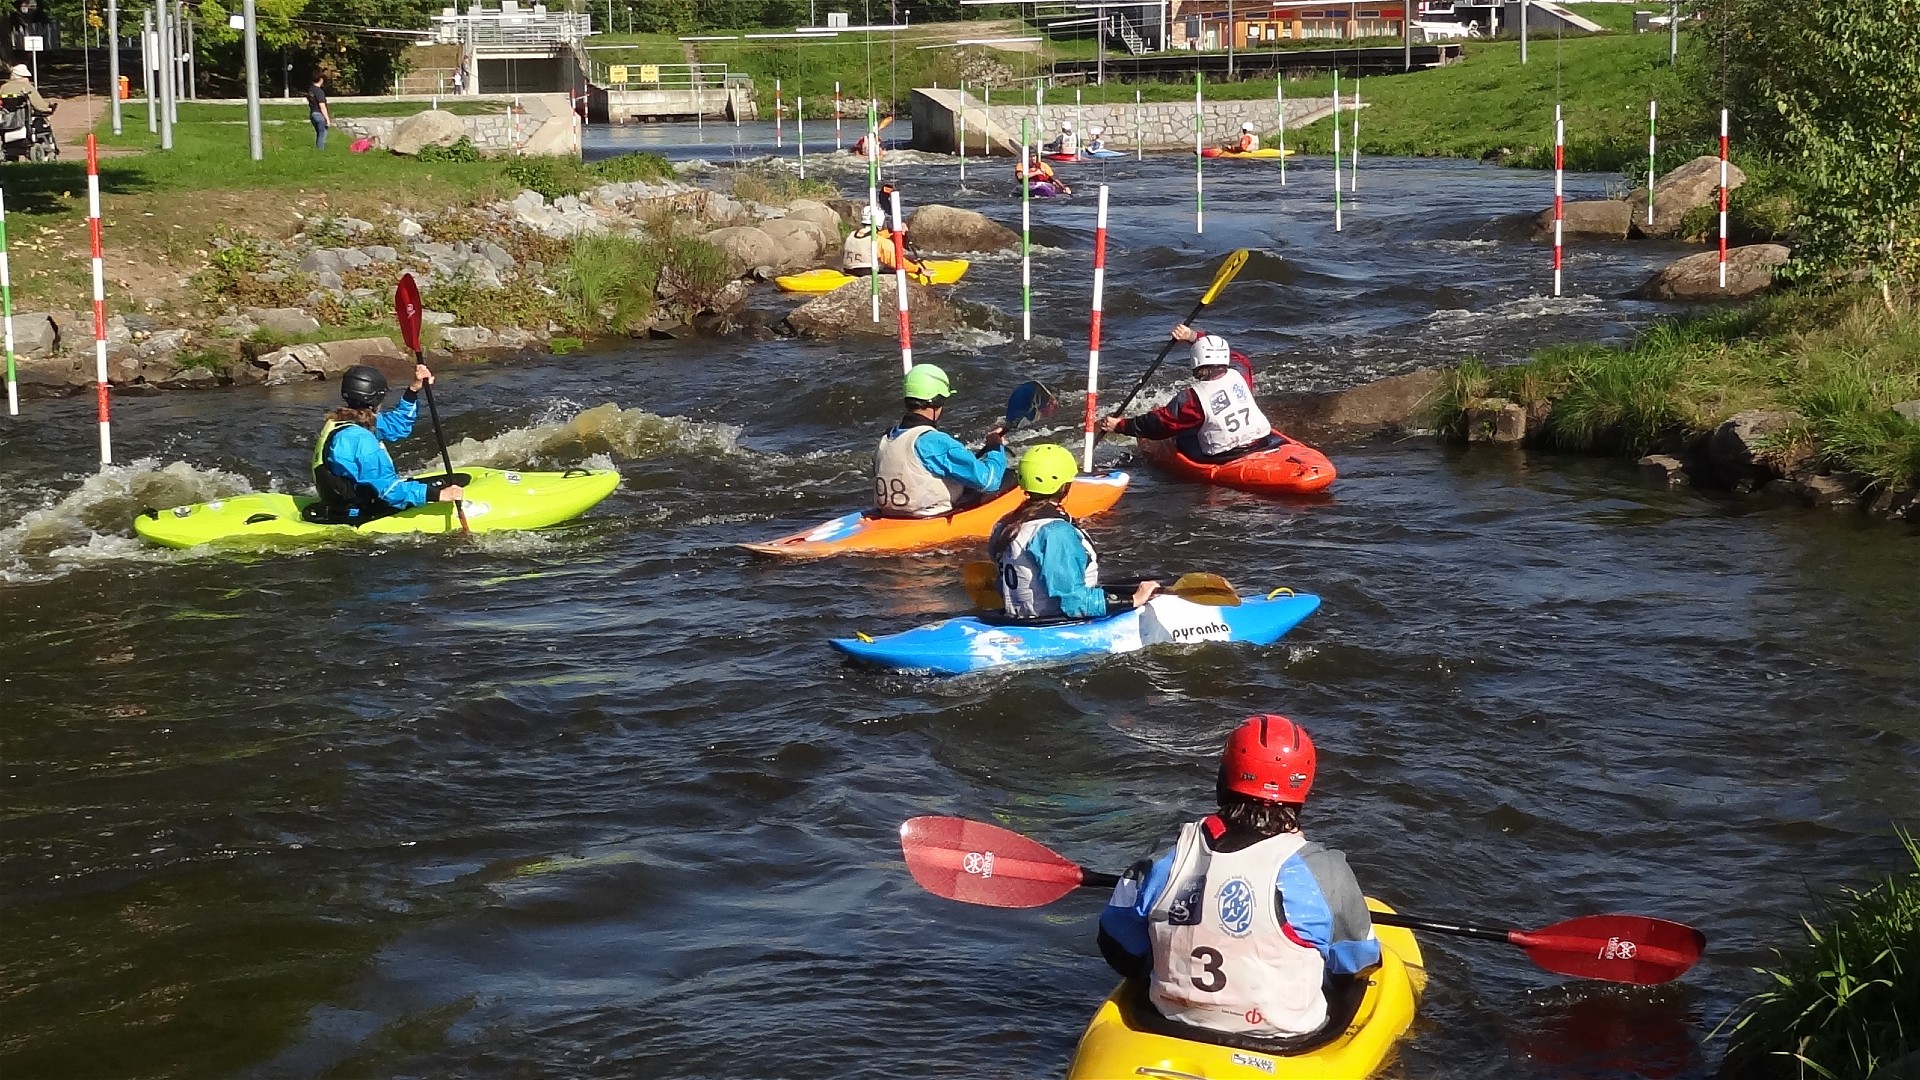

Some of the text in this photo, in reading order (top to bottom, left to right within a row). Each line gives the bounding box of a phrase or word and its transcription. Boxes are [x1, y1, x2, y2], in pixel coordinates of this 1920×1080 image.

[1224, 407, 1250, 433] 57
[875, 477, 910, 507] 98
[1172, 622, 1229, 641] pyranha
[1190, 946, 1227, 993] 3
